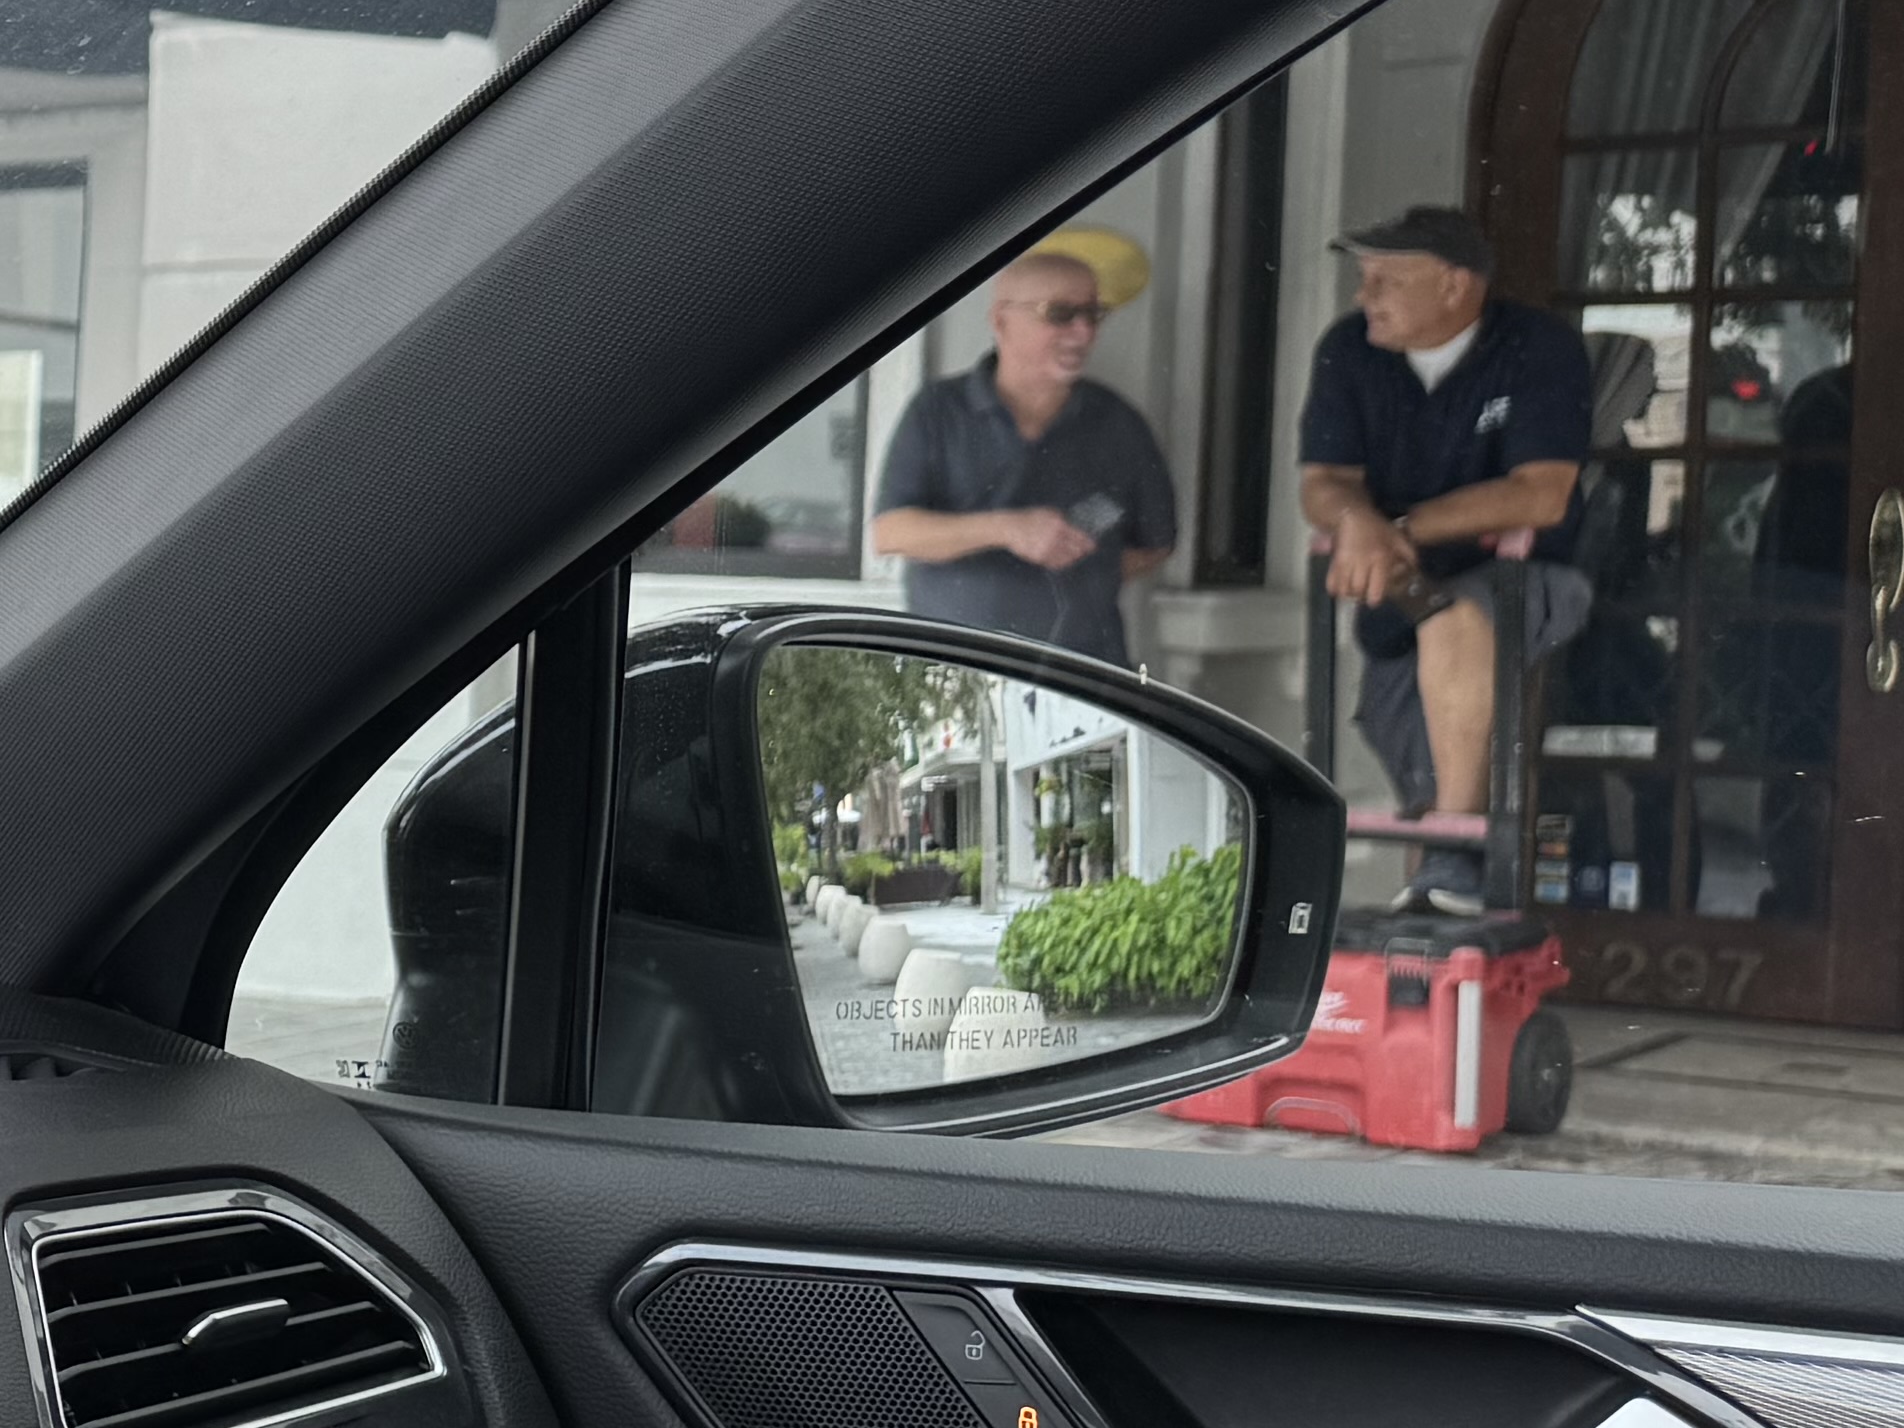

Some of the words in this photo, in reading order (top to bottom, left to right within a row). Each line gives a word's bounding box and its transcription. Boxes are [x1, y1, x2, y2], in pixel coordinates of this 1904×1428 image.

[835, 997, 922, 1021] OBJECTS
[927, 997, 943, 1017] IN
[948, 994, 1017, 1017] MIRROR
[891, 1030, 942, 1053] THAN
[948, 1028, 995, 1051] THEY
[1002, 1025, 1078, 1049] APPEAR
